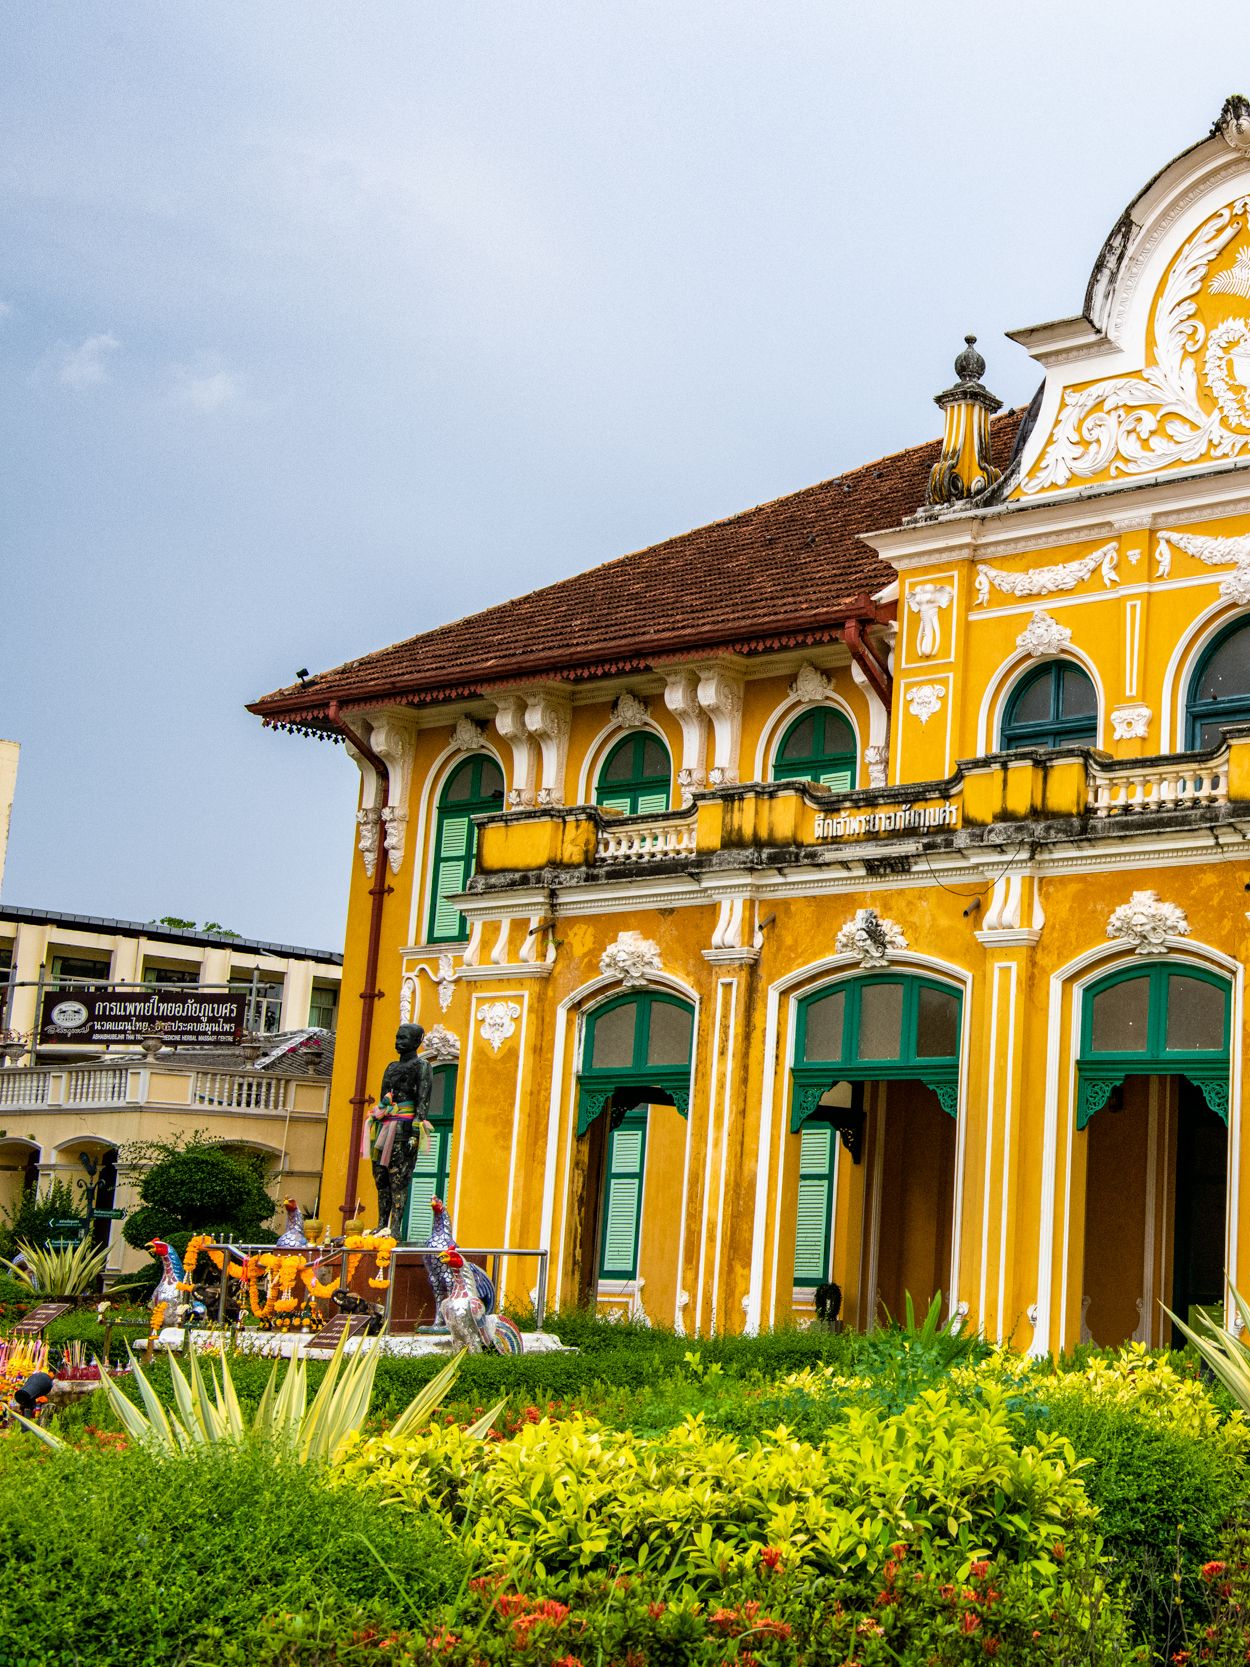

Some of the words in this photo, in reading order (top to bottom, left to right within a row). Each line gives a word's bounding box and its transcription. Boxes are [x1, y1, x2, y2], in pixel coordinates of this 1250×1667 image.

[95, 996, 238, 1021] การแพทย์ไทยอภัยภูเบศร
